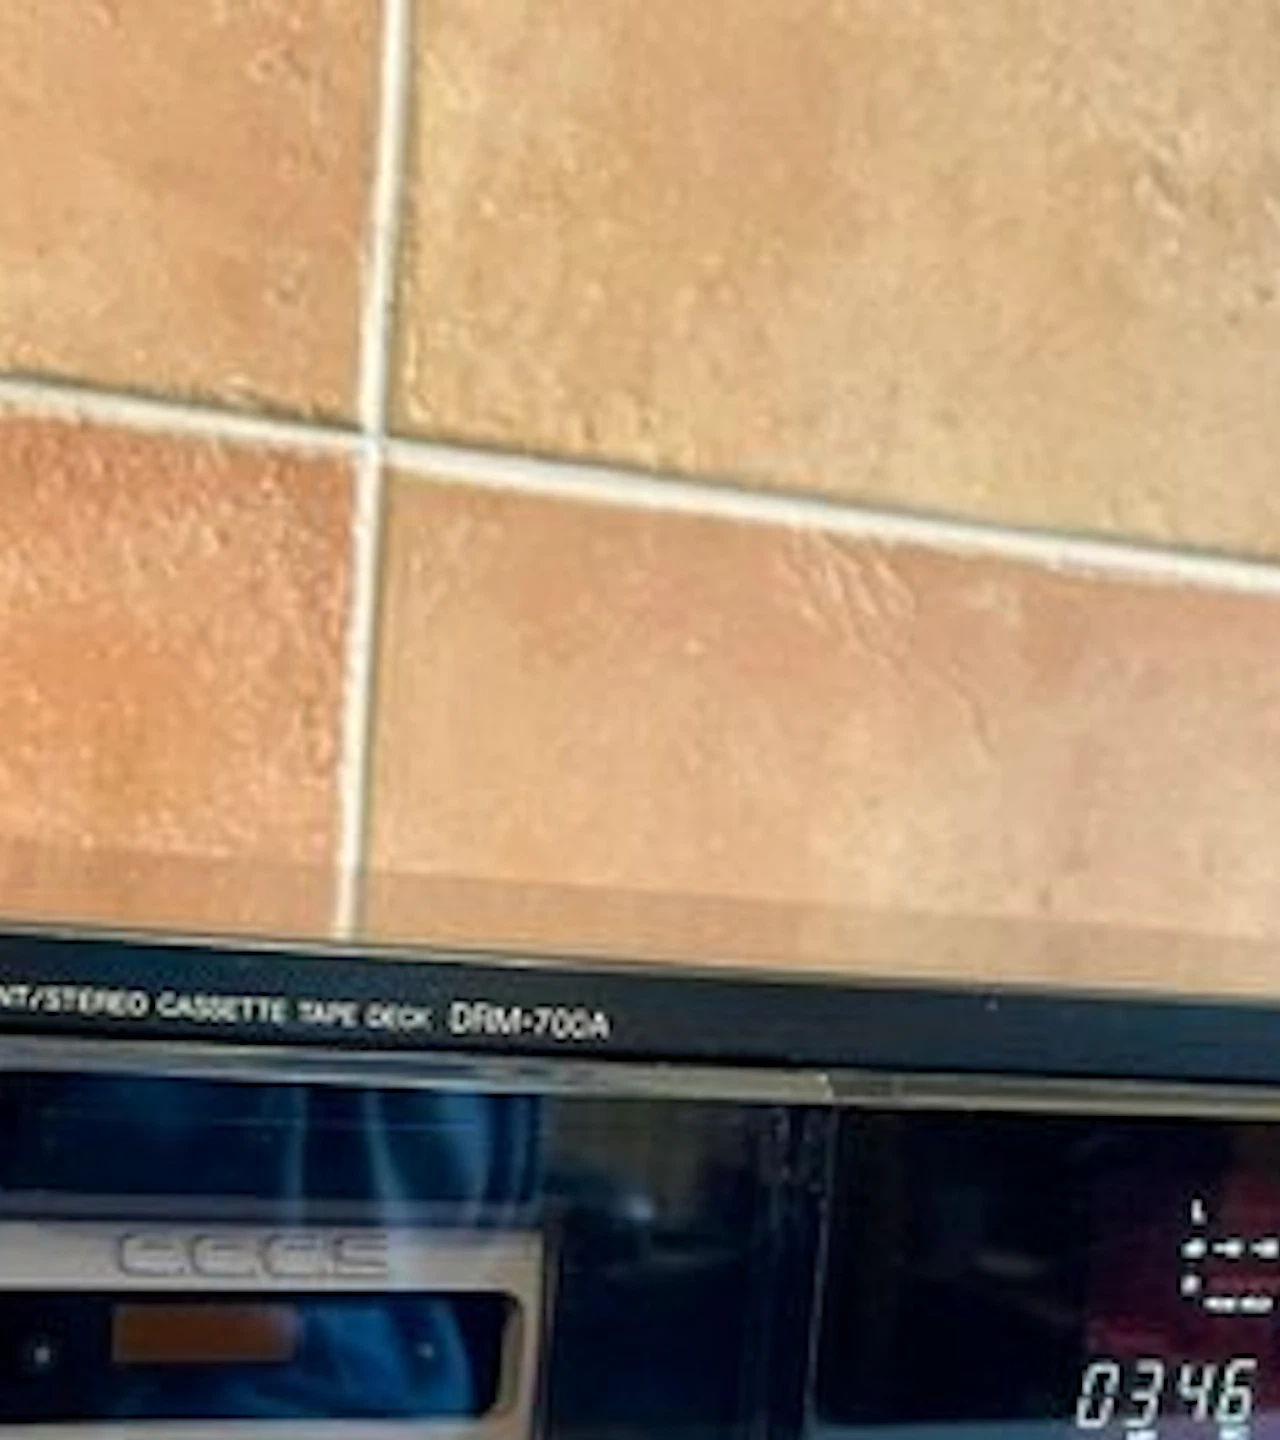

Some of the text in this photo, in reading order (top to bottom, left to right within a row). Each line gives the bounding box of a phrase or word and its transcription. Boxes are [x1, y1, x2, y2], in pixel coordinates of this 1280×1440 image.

[154, 991, 286, 1024] CASSETTE
[297, 1000, 356, 1028] TAPE
[364, 1001, 433, 1032] DECK
[449, 1000, 610, 1041] DRM-700A
[1076, 1357, 1258, 1428] 0346
